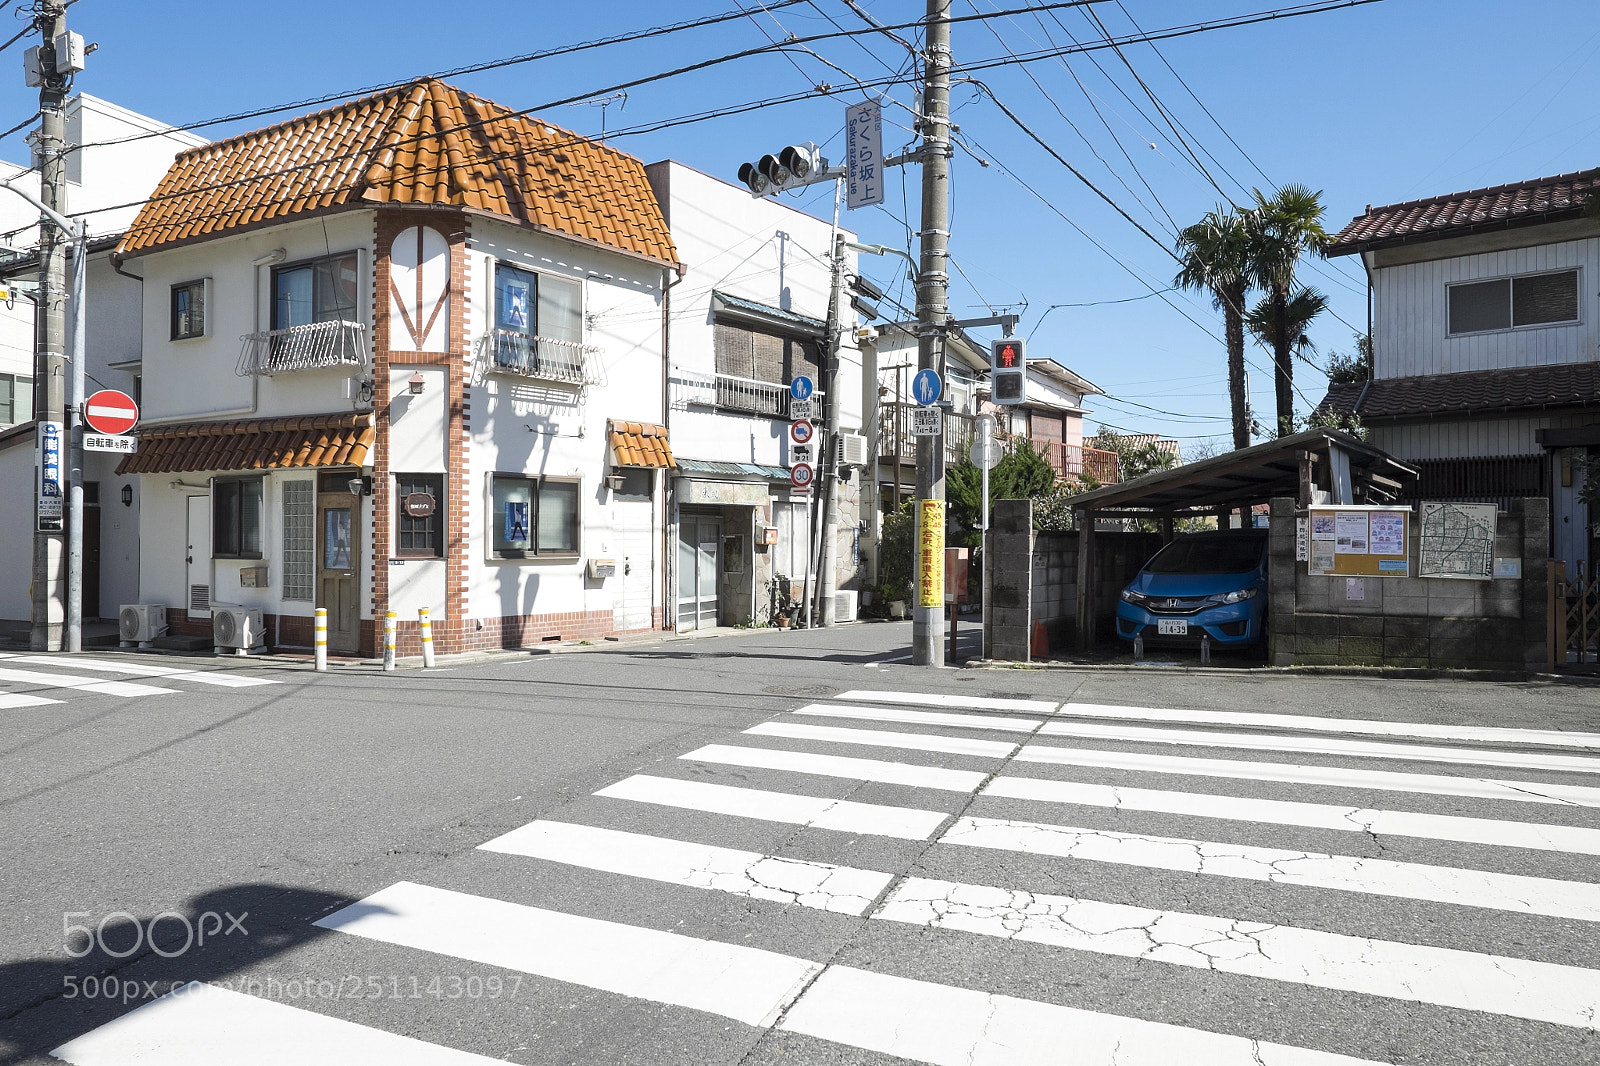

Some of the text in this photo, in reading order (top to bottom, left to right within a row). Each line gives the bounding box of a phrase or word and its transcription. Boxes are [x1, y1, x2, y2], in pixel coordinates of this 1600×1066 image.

[849, 118, 858, 195] Sakurazaka-ue
[858, 107, 875, 202] さくら坂上
[86, 438, 135, 450] 自転車を除く
[795, 469, 809, 481] 30
[1165, 625, 1186, 633] 14-39
